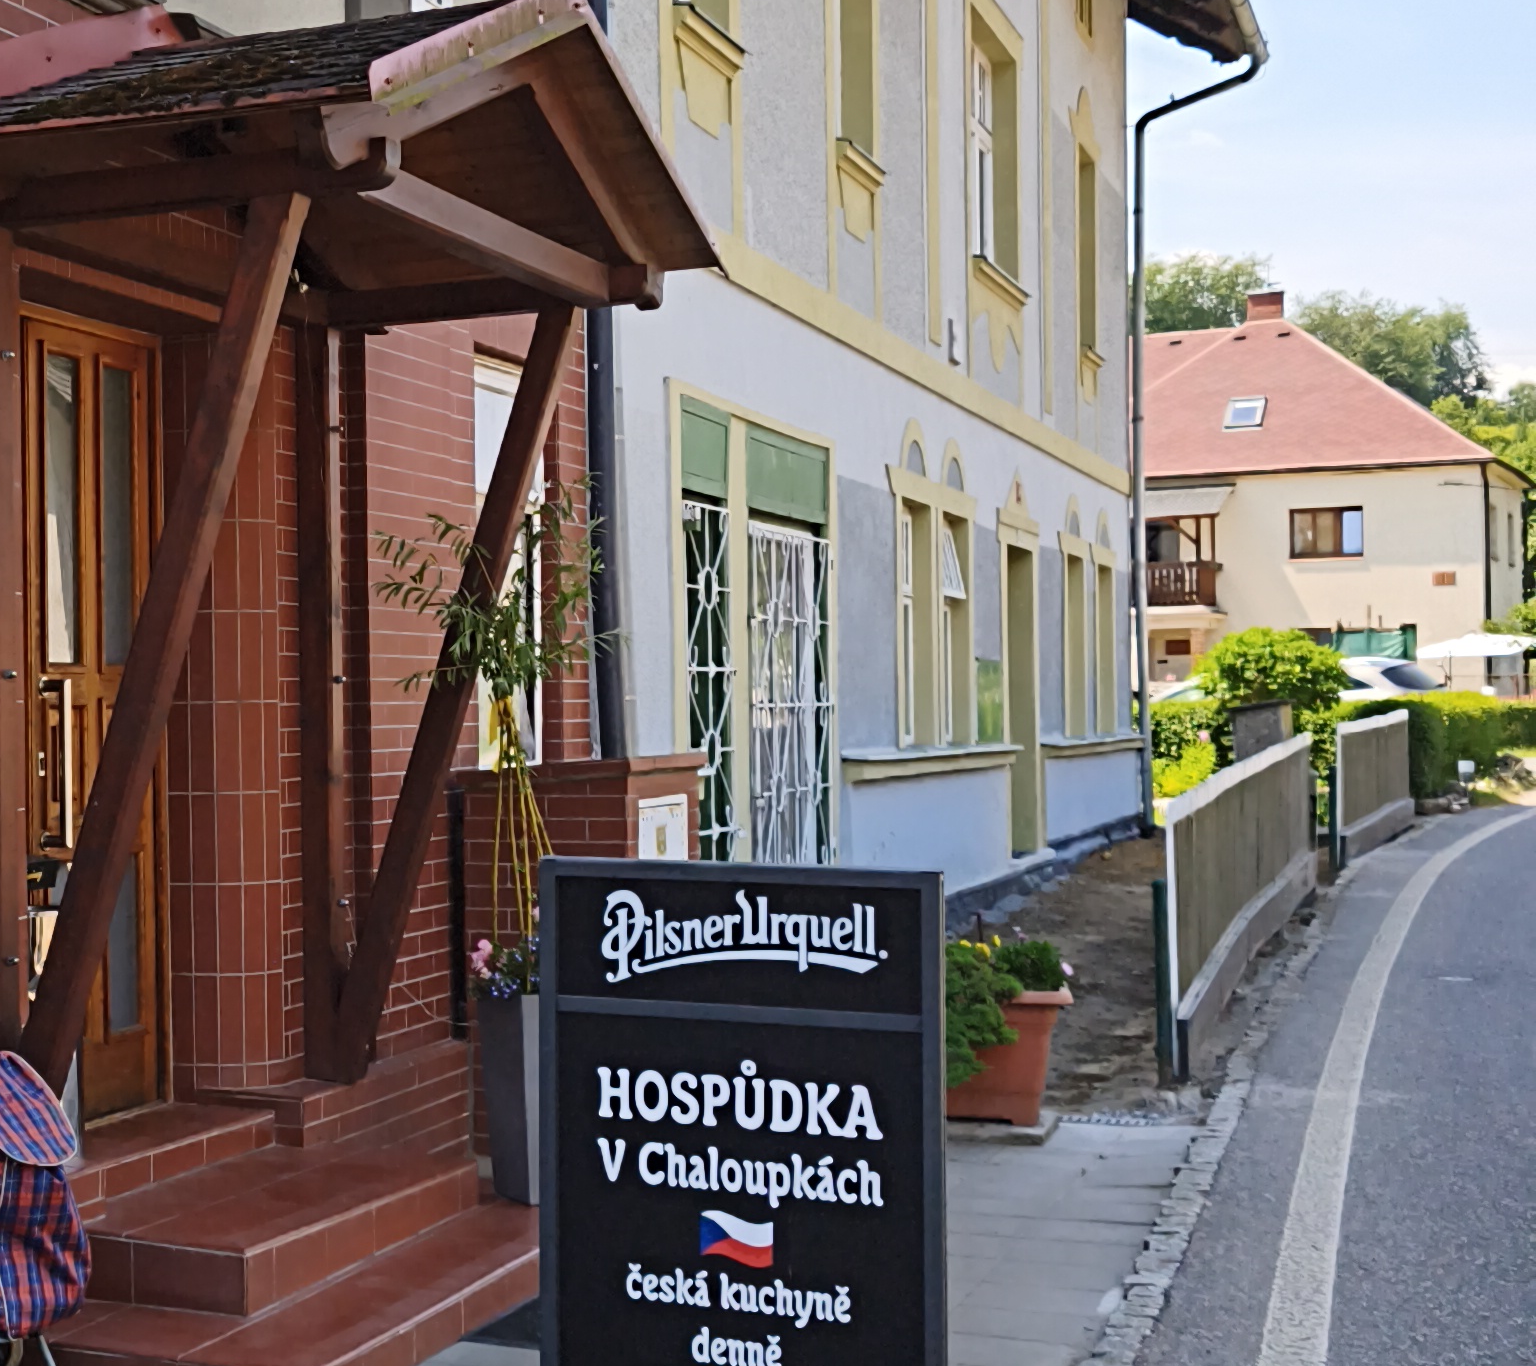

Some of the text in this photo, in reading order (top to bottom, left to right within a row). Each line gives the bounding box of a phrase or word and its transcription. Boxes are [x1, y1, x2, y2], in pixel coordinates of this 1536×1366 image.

[601, 889, 741, 983] Pilsner
[597, 1059, 884, 1141] HOSPŮDKA
[597, 1137, 884, 1209] V Chaloupkách
[625, 1262, 852, 1329] česká kuchyně
